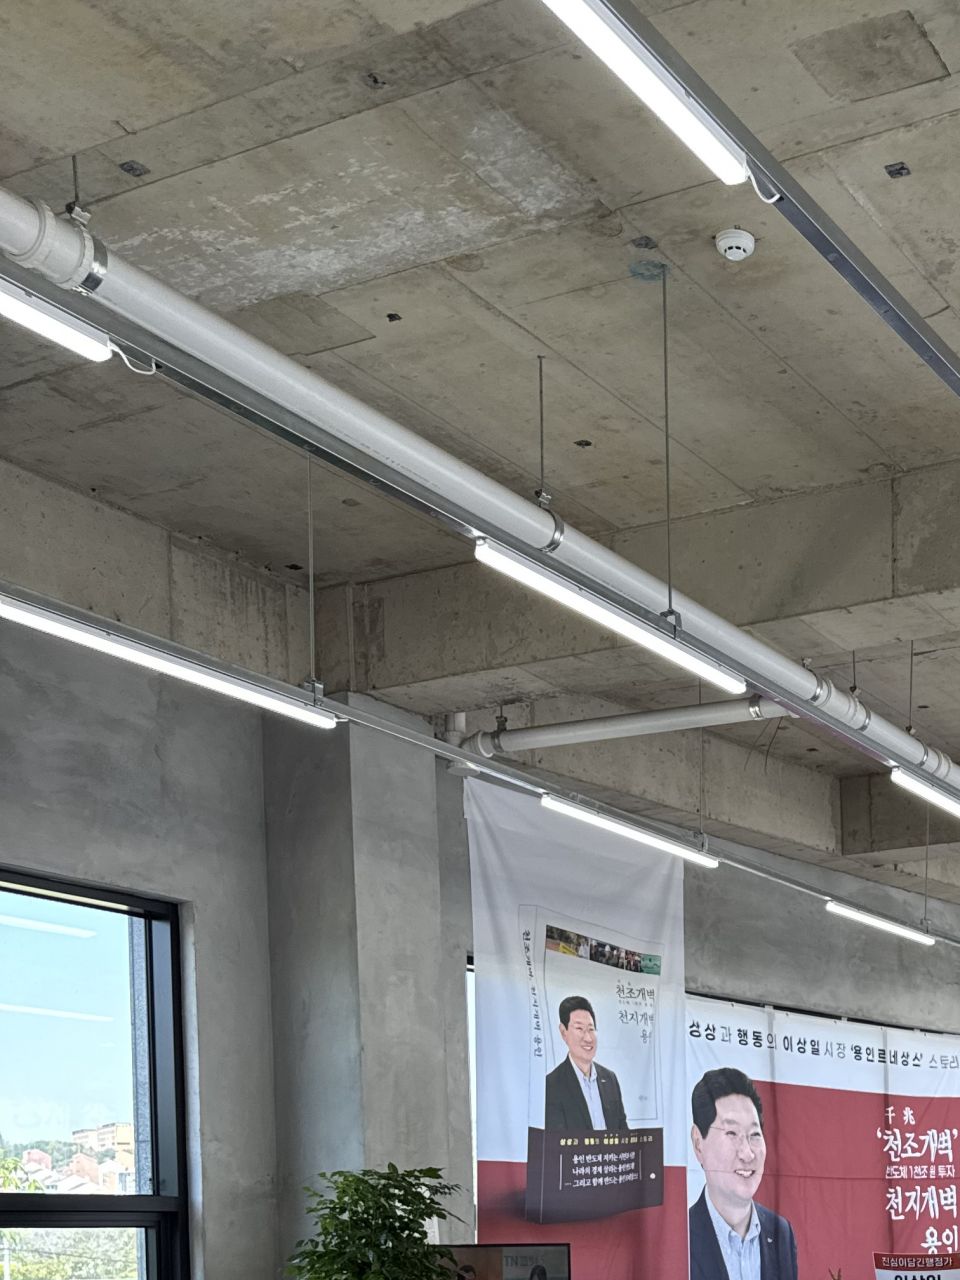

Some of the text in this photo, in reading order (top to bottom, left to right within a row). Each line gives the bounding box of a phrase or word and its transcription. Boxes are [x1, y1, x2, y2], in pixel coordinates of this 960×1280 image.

[688, 1020, 731, 1043] 상상과
[737, 1028, 777, 1050] 행동의
[783, 1034, 821, 1056] 이상일
[823, 1041, 846, 1059] 시장
[928, 1055, 960, 1069] 스토리
[937, 1164, 956, 1178] 투자
[886, 1184, 958, 1221] 천지개벽
[919, 1225, 959, 1254] 용인
[882, 1256, 953, 1269] 진심이담긴행정가
